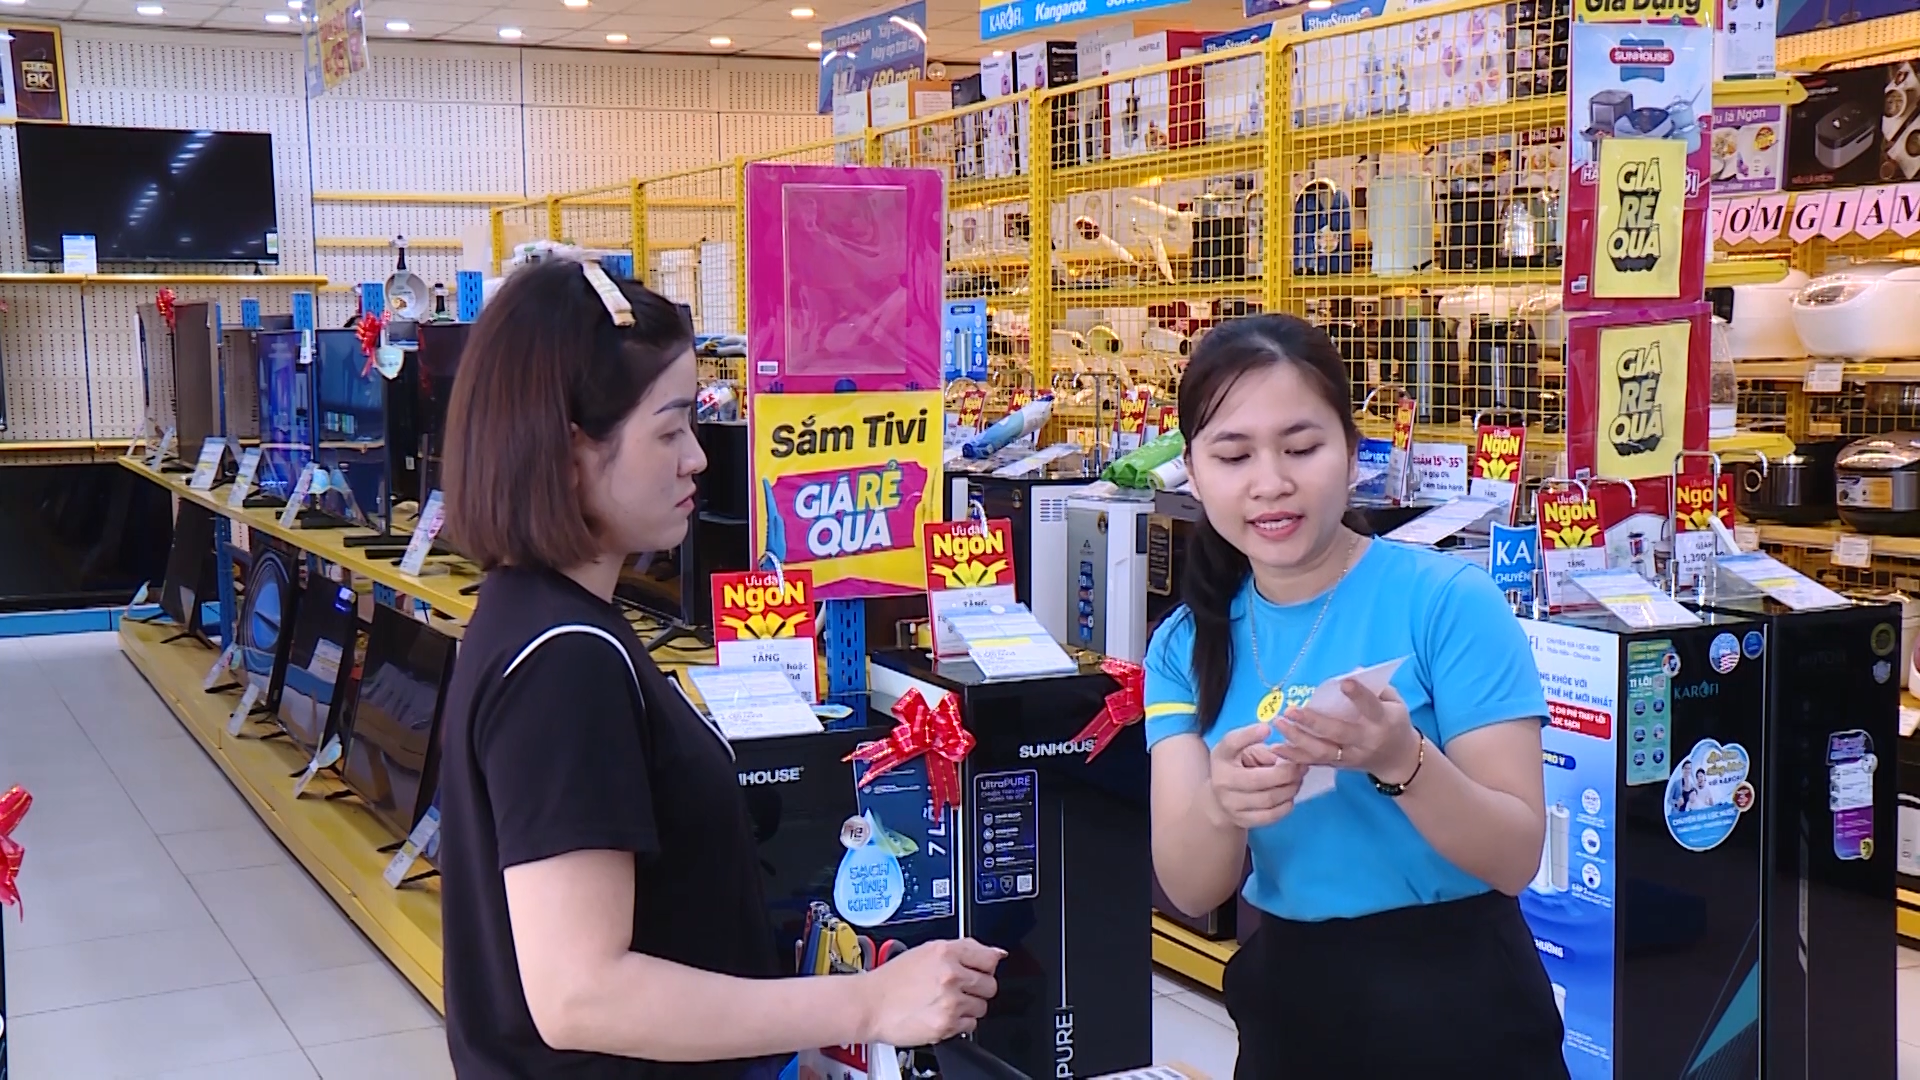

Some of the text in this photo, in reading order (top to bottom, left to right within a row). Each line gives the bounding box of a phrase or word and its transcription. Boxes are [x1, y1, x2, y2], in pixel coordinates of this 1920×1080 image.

[989, 4, 1022, 32] KAROFI
[1035, 0, 1086, 21] Kangaroo
[1613, 50, 1671, 63] SUNHOUSE
[26, 72, 51, 88] 8K
[1737, 108, 1766, 122] Ngon
[1617, 157, 1661, 192] GIÁ
[1619, 188, 1656, 229] RẺ
[1607, 223, 1661, 259] QUÁ
[1616, 340, 1662, 379] GIÁ
[771, 408, 928, 458] Sắm Tivi
[1608, 403, 1664, 445] QUÁ
[1481, 433, 1520, 458] NgoN
[795, 460, 902, 518] GIÁ RẺ
[1677, 483, 1728, 508] NgoN
[1544, 499, 1597, 526] NgoN
[808, 507, 892, 557] QUÁ
[932, 529, 1004, 562] NgoN
[723, 581, 805, 613] NgoN
[1674, 681, 1719, 699] KAROFI
[1019, 739, 1097, 758] SUNHOUS
[981, 775, 1031, 790] UltraPURE
[928, 841, 947, 856] 7
[849, 862, 890, 882] SẠCH
